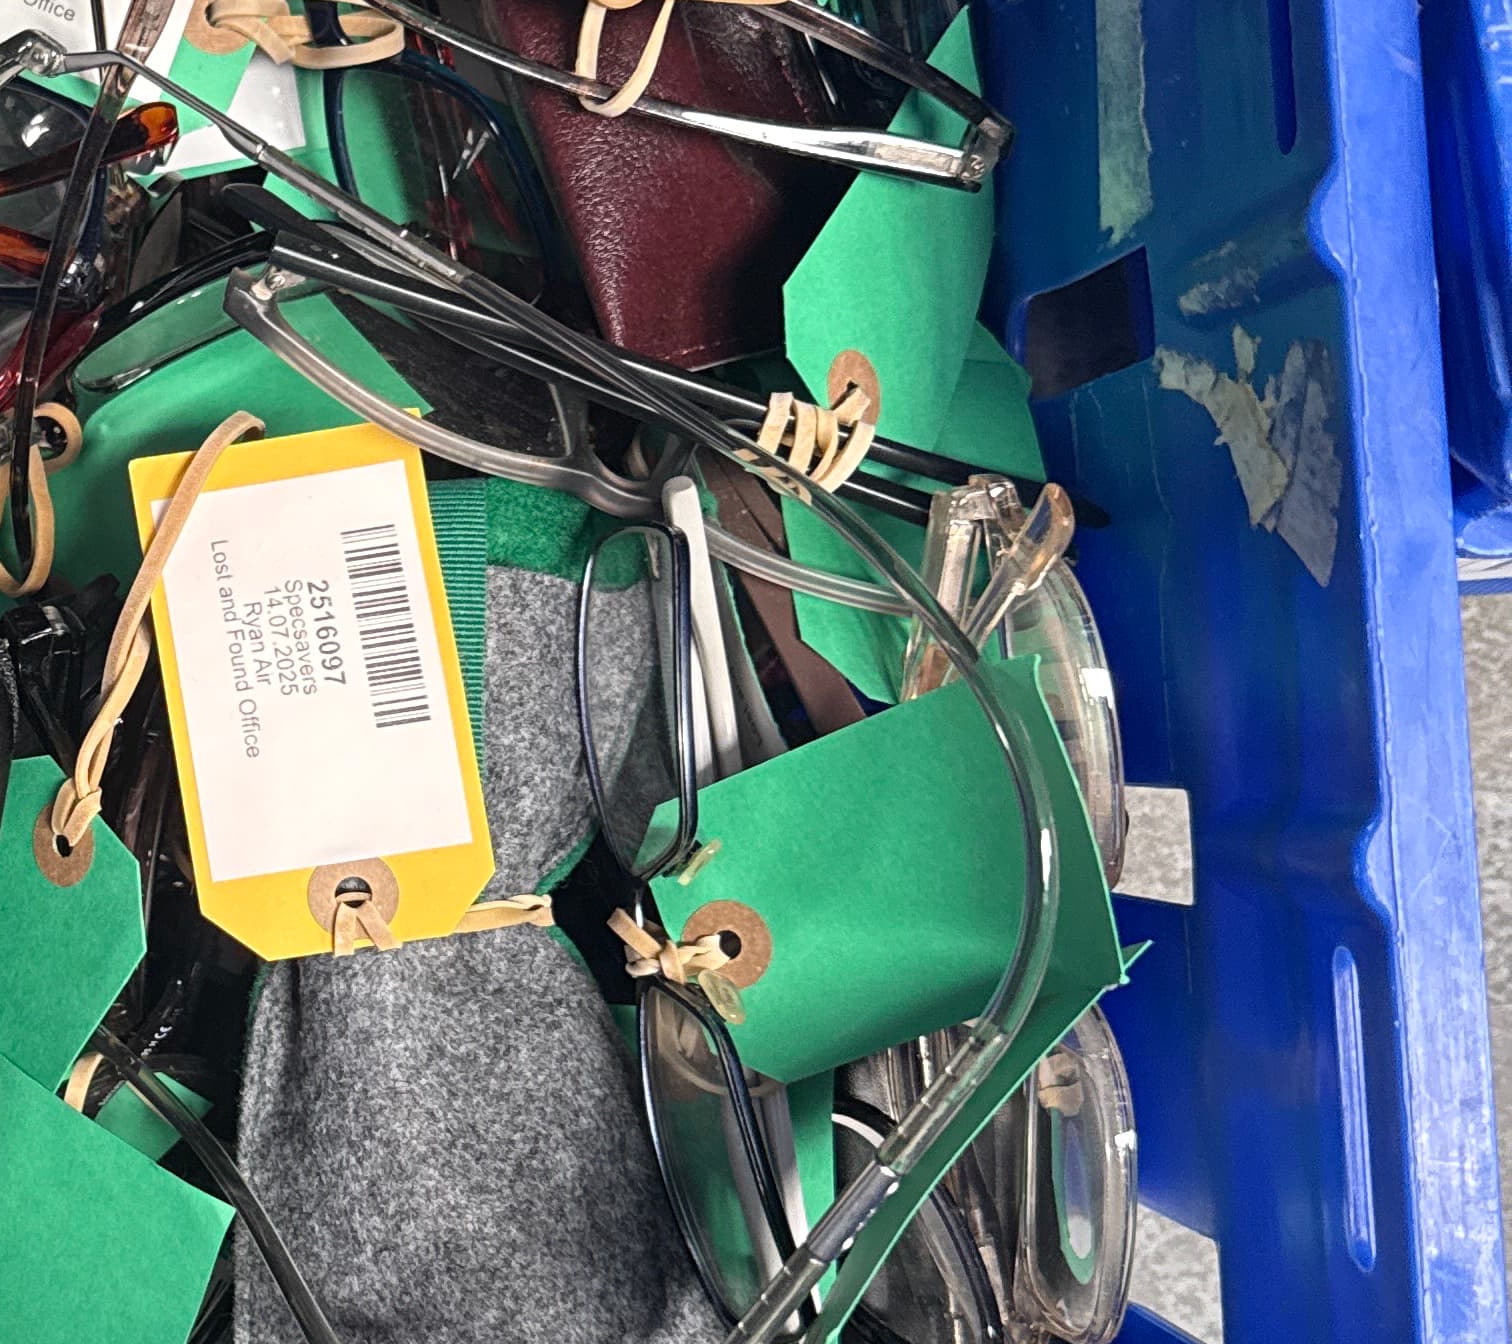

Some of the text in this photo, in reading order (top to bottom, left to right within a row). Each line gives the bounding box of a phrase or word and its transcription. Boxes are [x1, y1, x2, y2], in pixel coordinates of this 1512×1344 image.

[210, 539, 260, 758] Lost and Found Office
[241, 601, 272, 685] Ryan Air
[263, 586, 299, 695] 14.07.2025
[283, 579, 317, 695] Specsavers
[306, 579, 346, 684] 2516097
